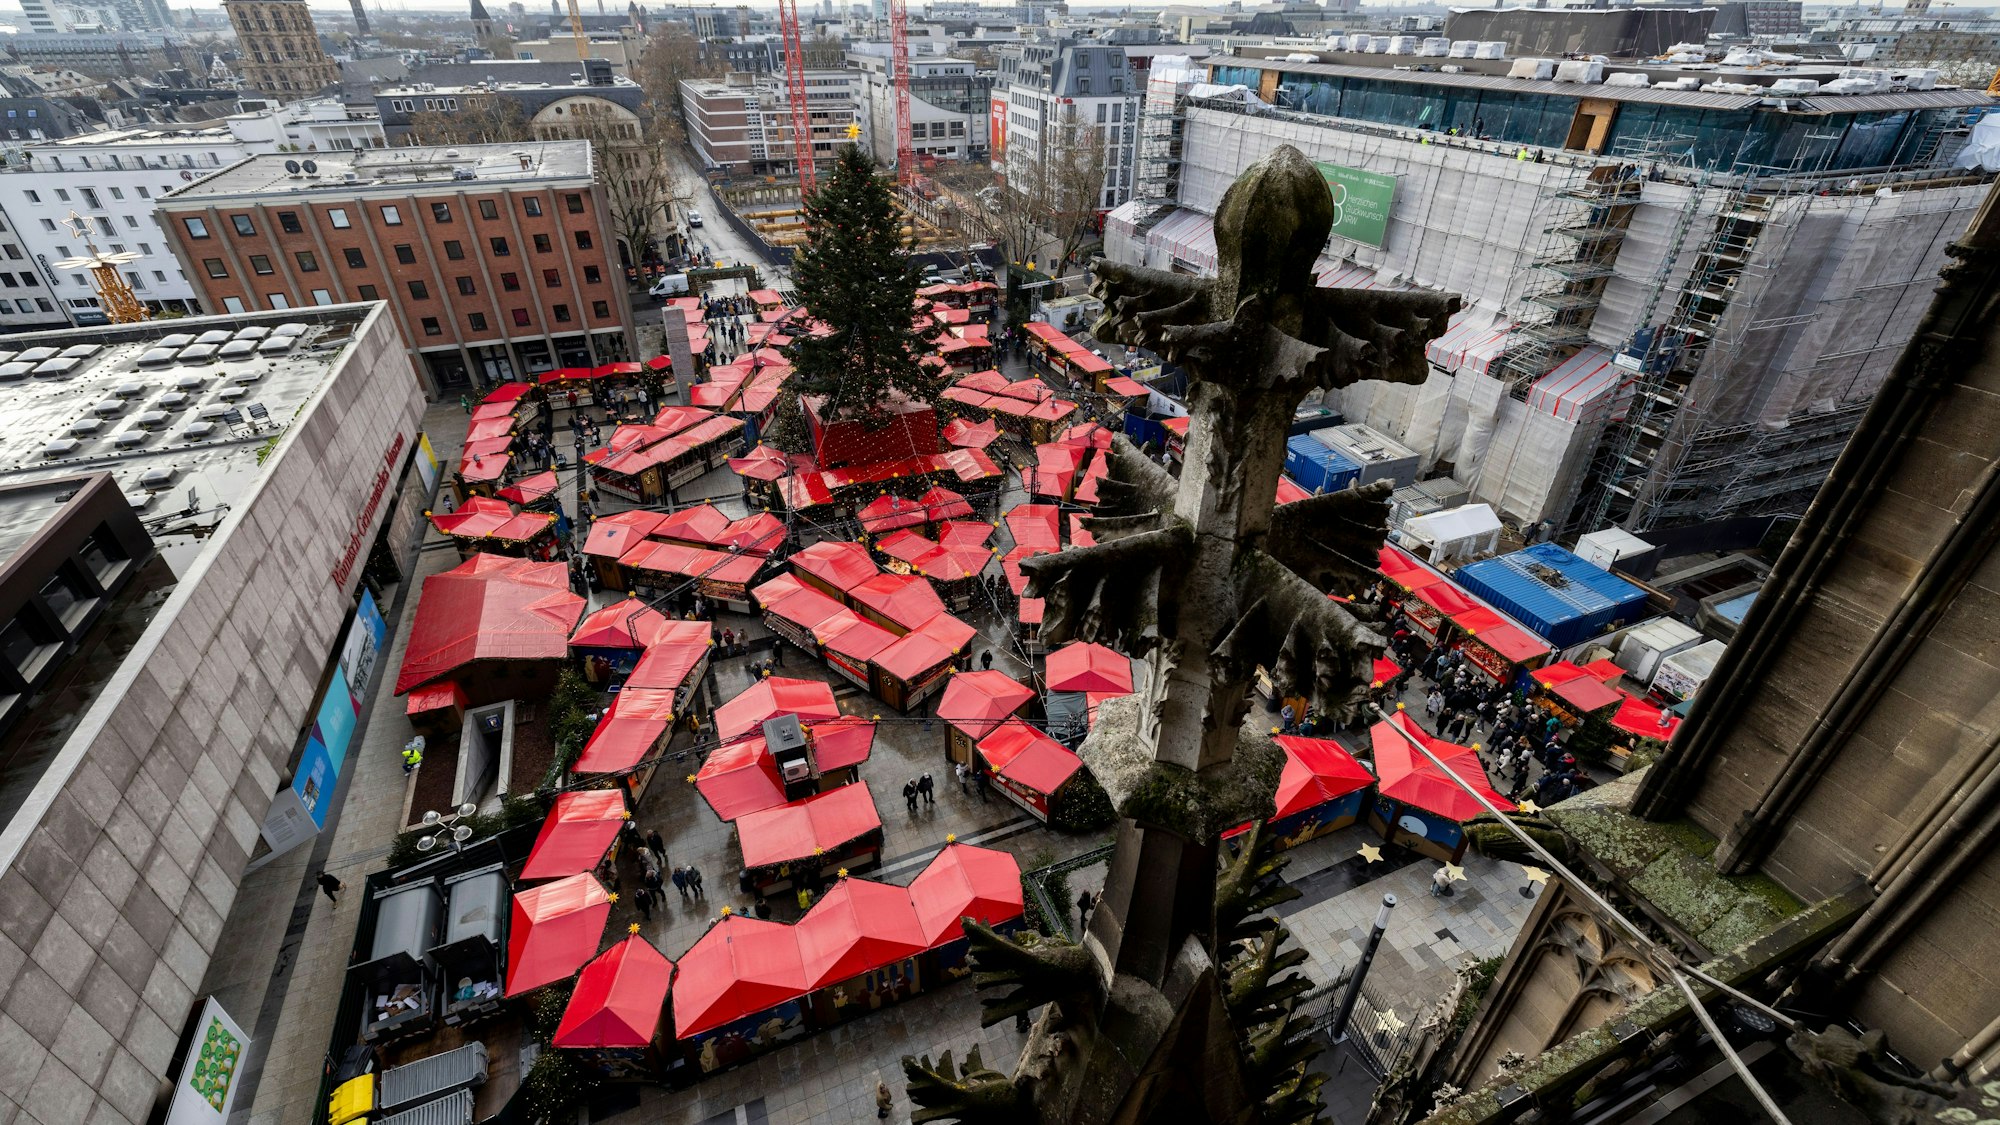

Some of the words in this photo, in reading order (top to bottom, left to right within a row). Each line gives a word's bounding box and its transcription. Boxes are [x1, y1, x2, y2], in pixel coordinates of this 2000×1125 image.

[1347, 194, 1378, 209] Herzlichen
[1343, 214, 1358, 225] NRW
[384, 431, 404, 472] Museum
